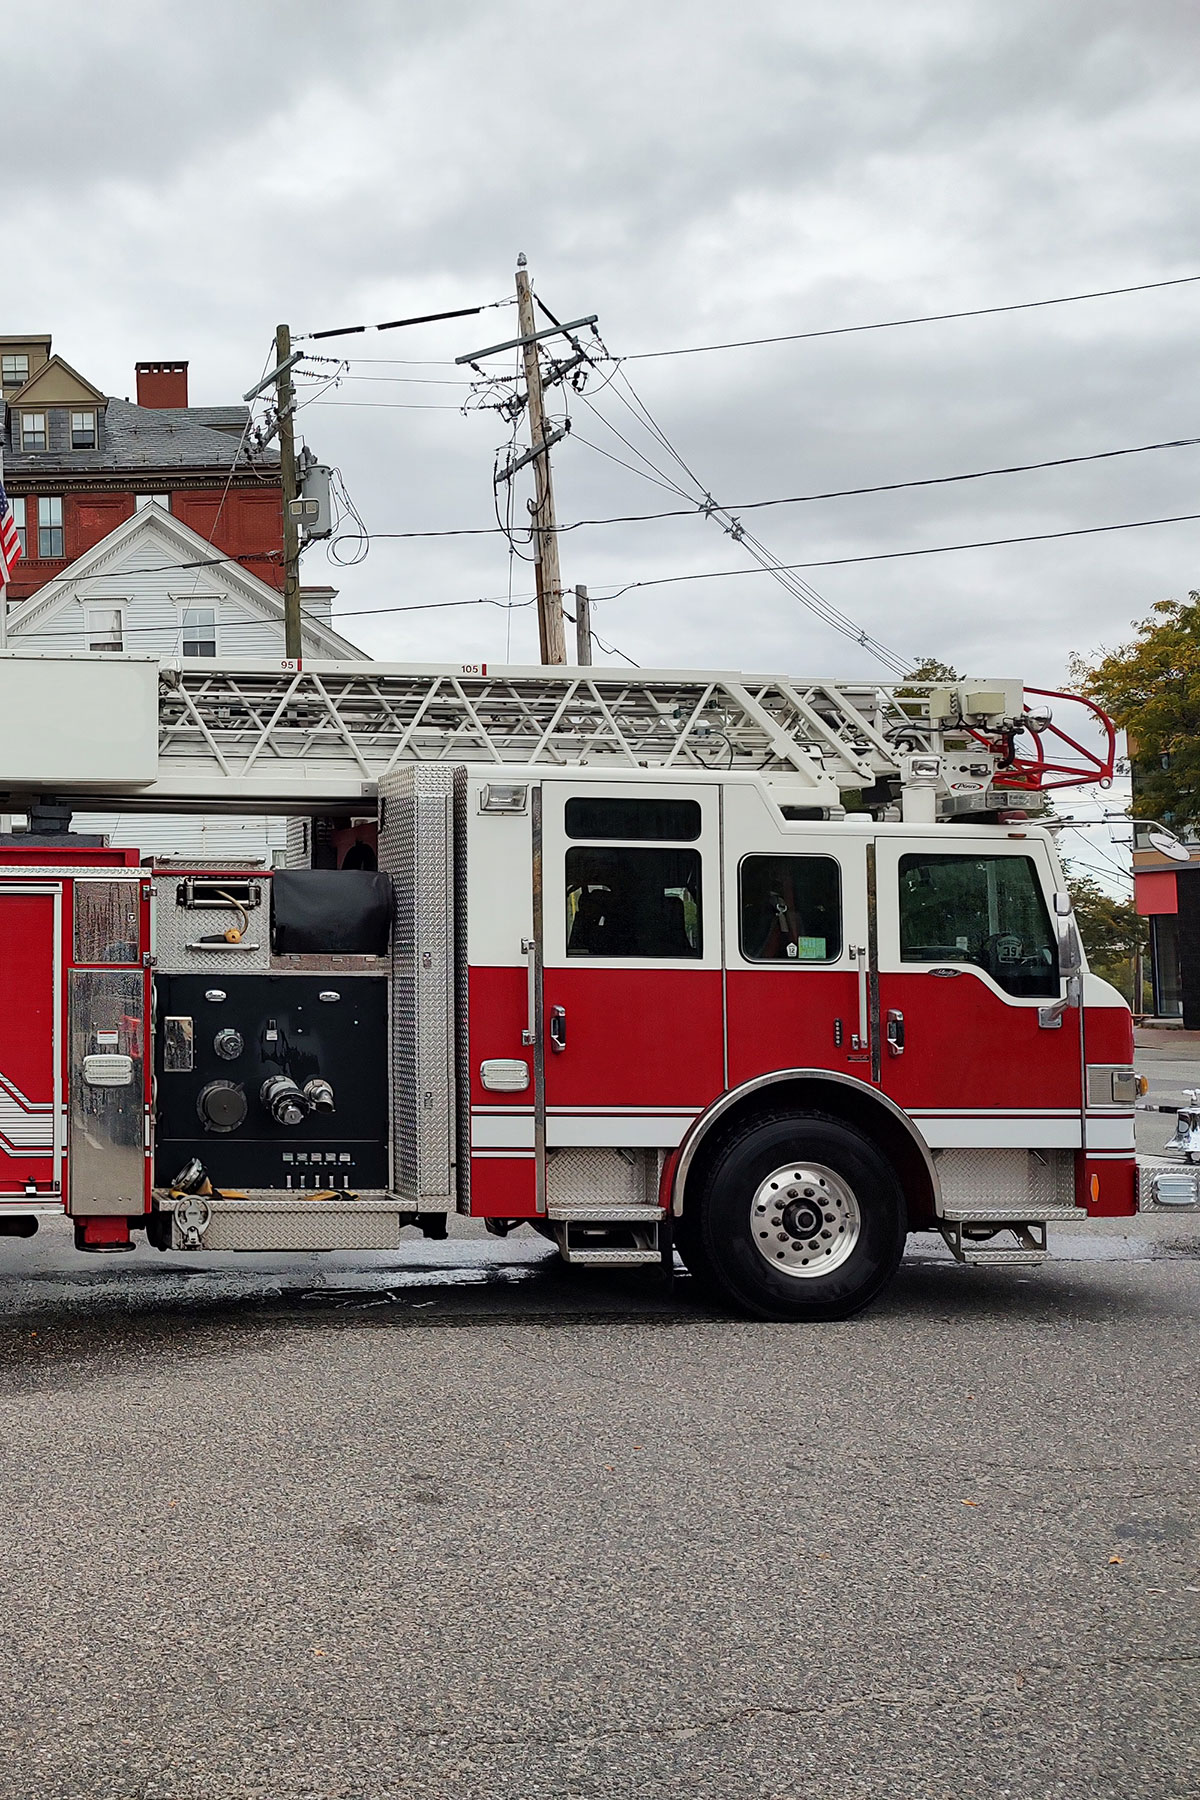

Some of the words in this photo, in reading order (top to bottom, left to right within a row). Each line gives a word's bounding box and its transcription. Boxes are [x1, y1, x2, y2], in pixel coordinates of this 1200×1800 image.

[281, 661, 294, 669] 95
[461, 665, 479, 673] 105
[1003, 946, 1017, 956] 39
